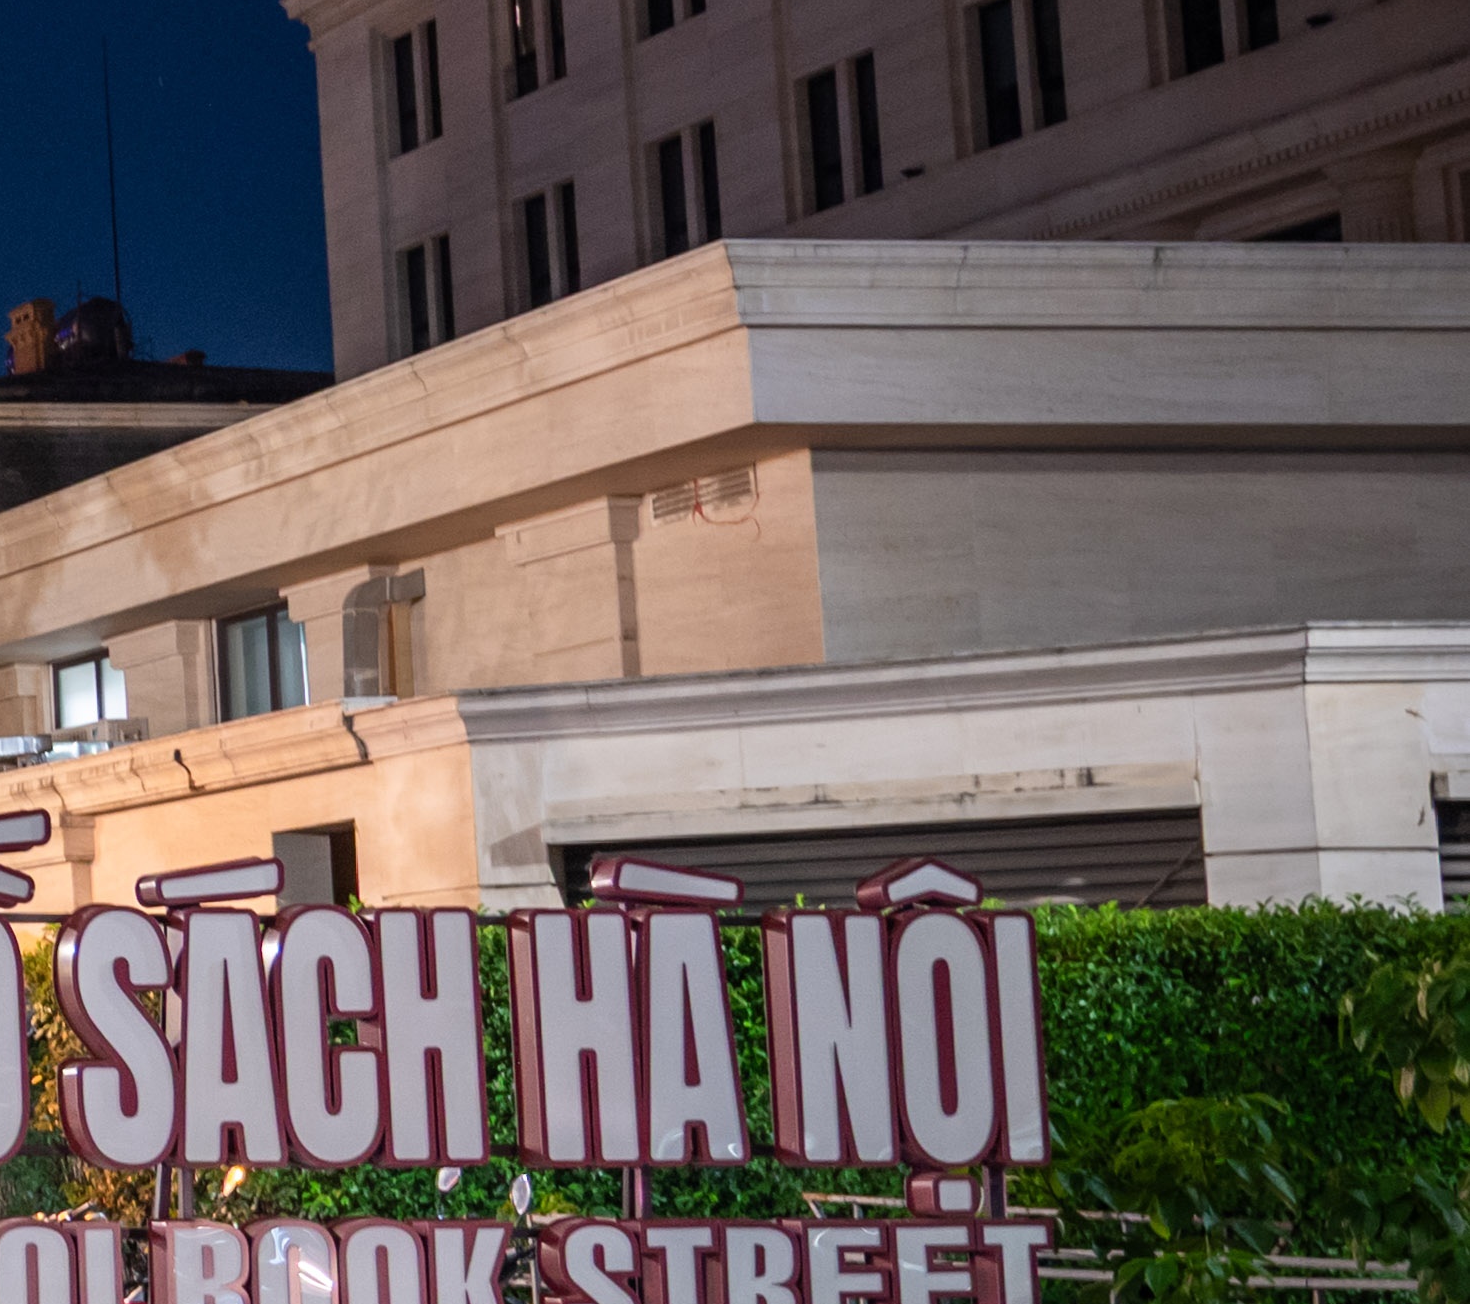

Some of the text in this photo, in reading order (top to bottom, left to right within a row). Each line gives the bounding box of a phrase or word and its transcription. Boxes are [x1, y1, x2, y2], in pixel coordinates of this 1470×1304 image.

[54, 857, 490, 1170] SÁCH
[507, 855, 751, 1166] HÀ
[764, 855, 1051, 1217] NỘI
